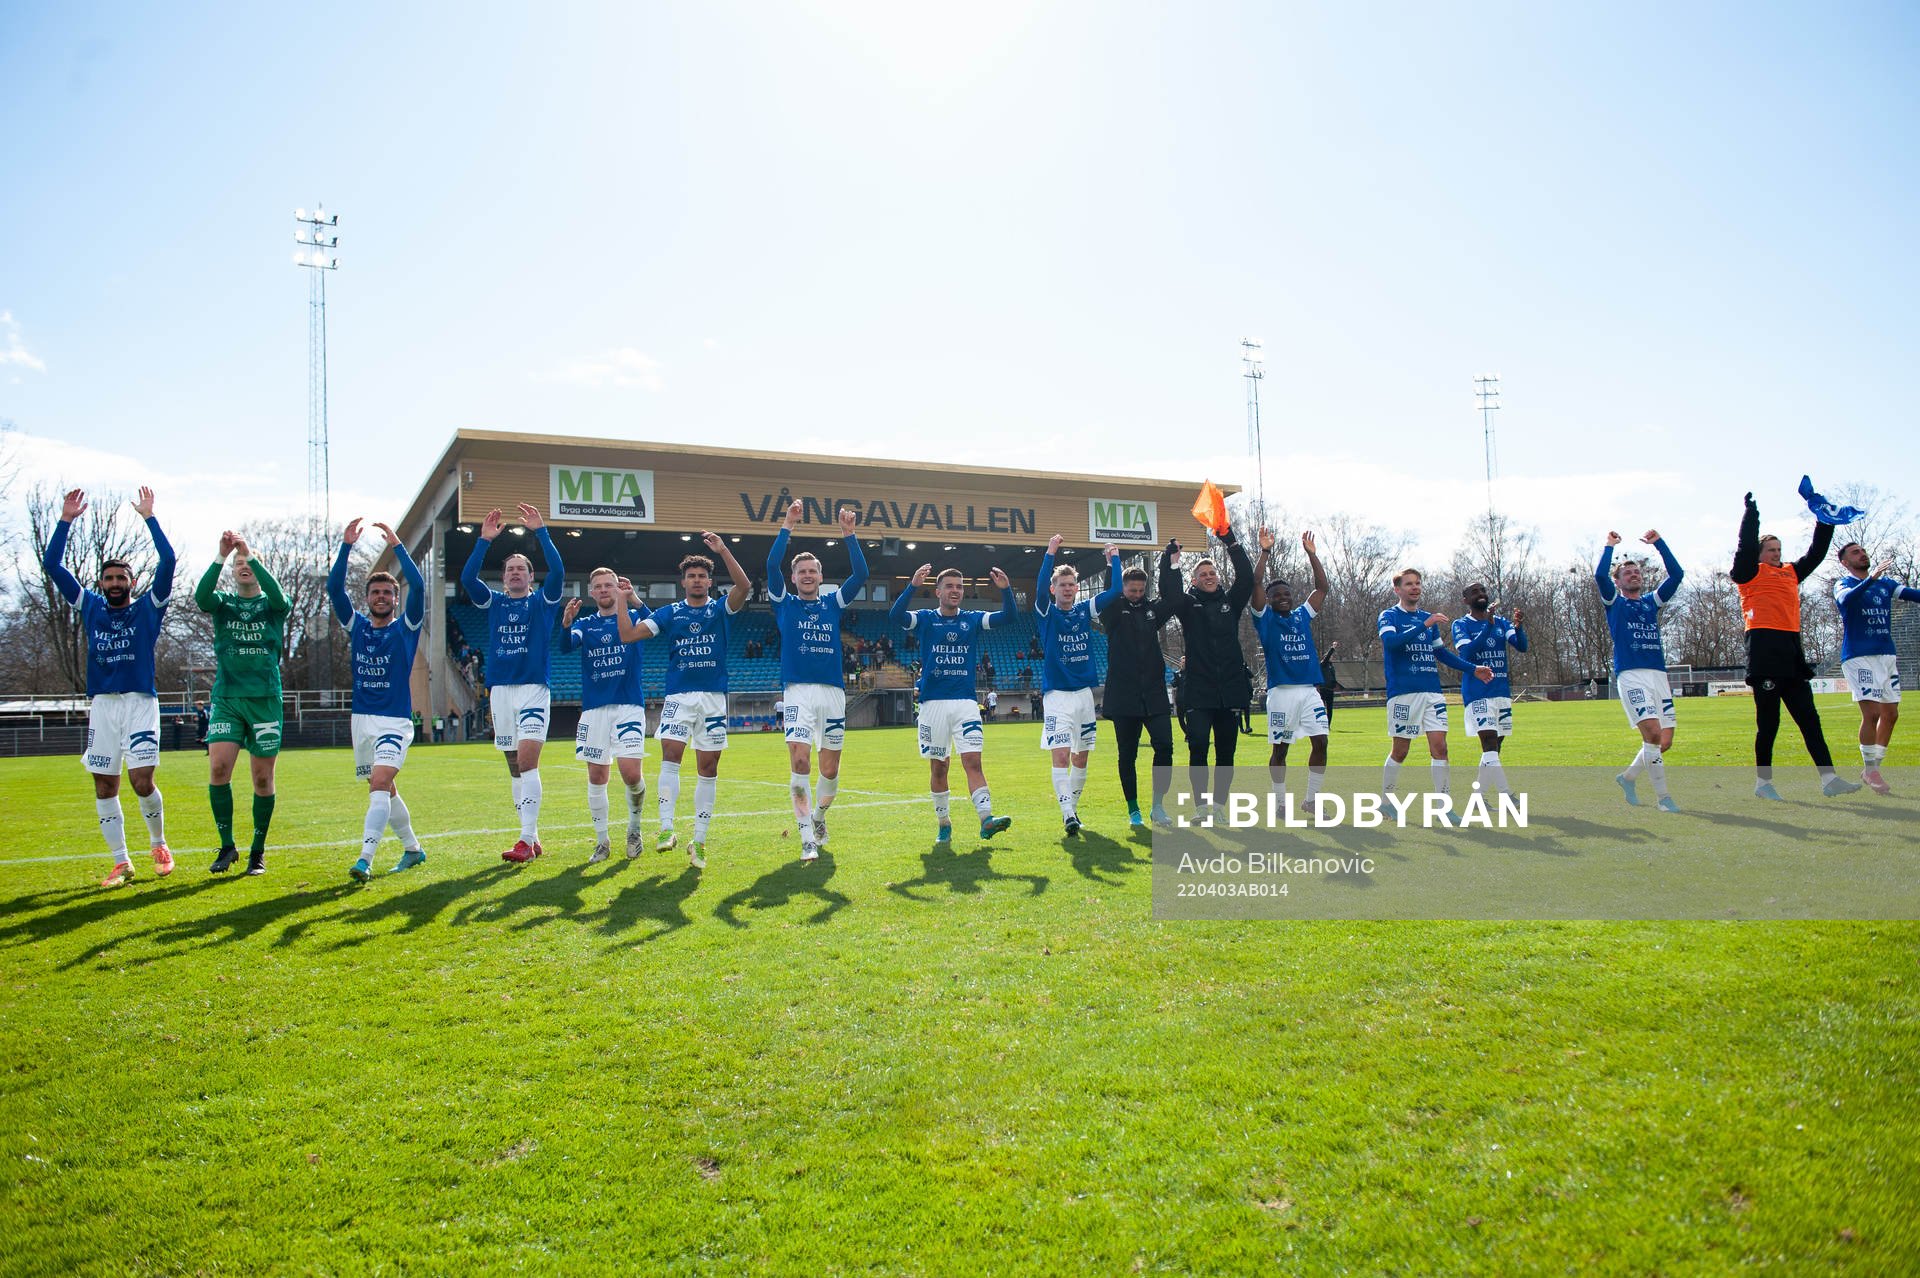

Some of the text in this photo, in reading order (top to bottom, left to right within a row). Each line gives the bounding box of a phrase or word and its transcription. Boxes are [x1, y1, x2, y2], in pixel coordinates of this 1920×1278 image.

[558, 469, 643, 504] MTA
[560, 505, 644, 517] Bygg och Anläggning
[739, 487, 1036, 534] VÅNGAVALLEN
[1094, 502, 1149, 529] MTA
[802, 631, 831, 642] GÅRD
[97, 639, 130, 651] GÅRD
[587, 644, 628, 658] MELLBY
[679, 645, 712, 657] GÅRD
[931, 644, 970, 654] MELLBY
[593, 656, 623, 668] GÅRD
[935, 654, 965, 665] GÅRD
[357, 665, 386, 676] GÅRD
[584, 746, 604, 754] INTER
[88, 760, 111, 768] SPORT
